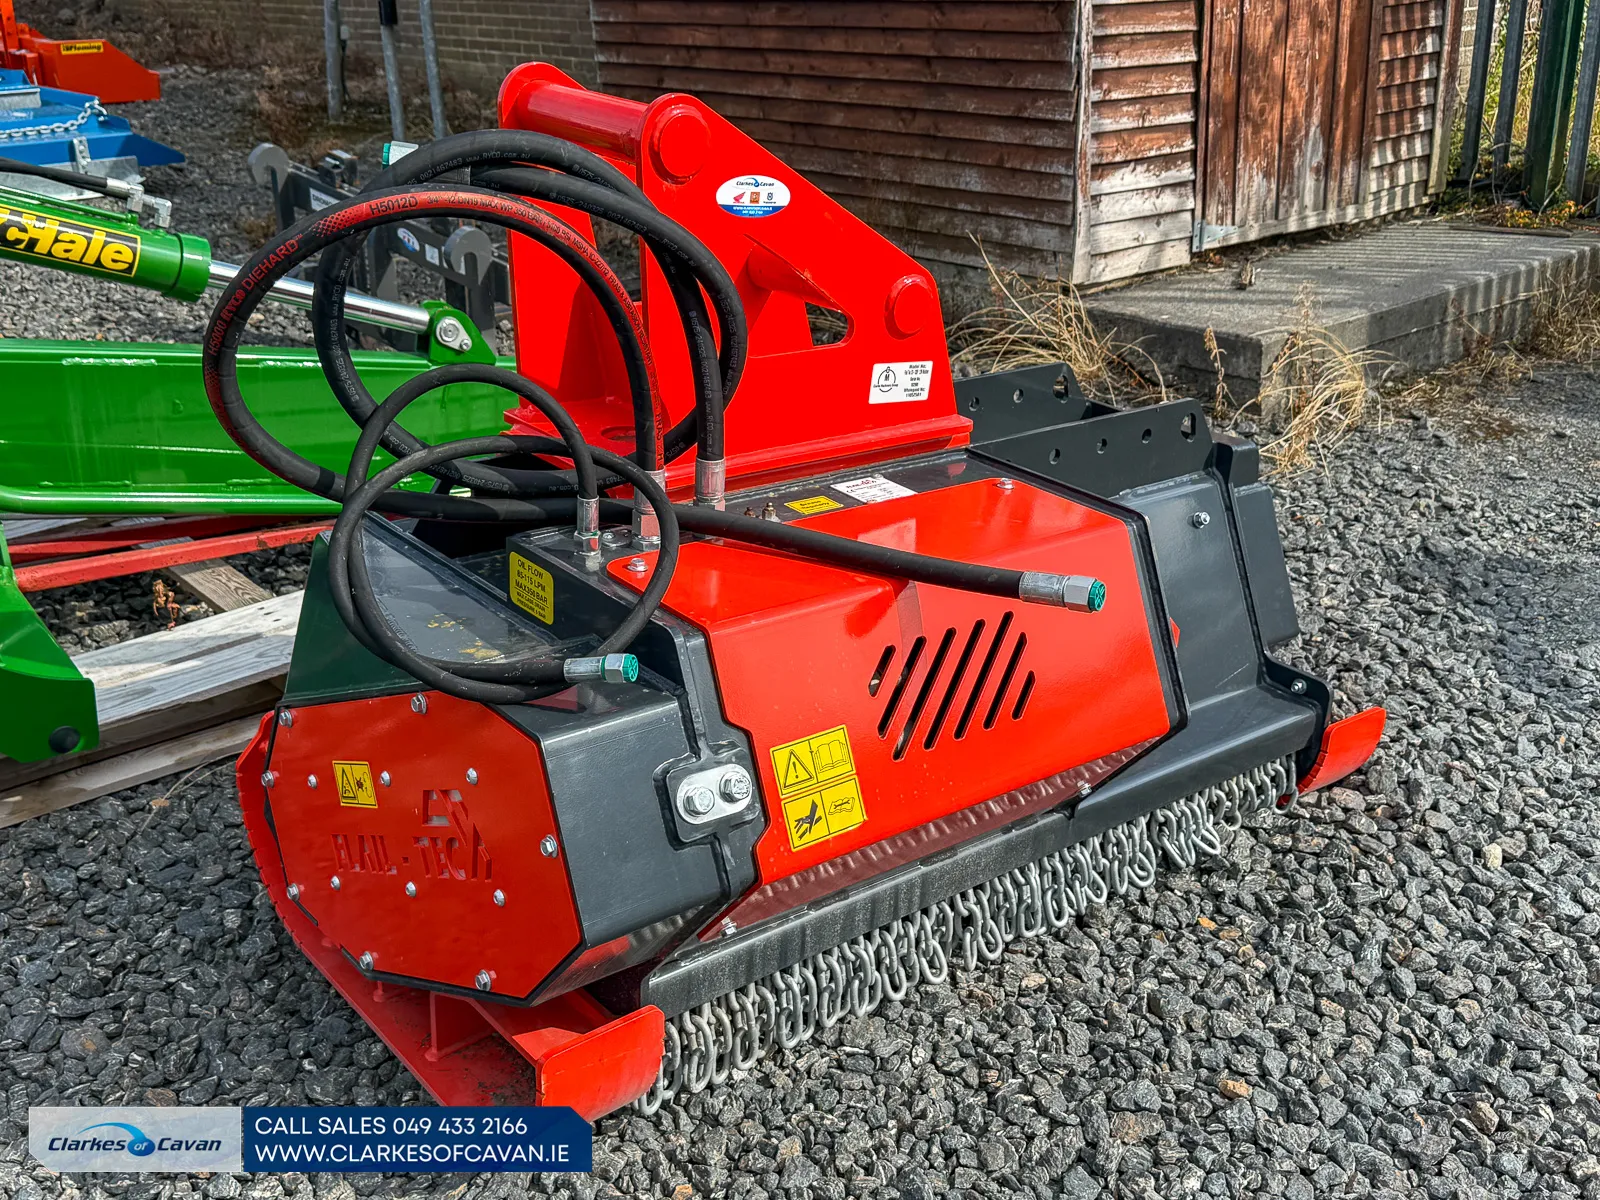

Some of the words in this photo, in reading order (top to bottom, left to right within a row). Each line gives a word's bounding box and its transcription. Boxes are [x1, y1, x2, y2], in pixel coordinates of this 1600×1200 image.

[369, 195, 419, 215] H5012D
[458, 196, 478, 206] DN19
[480, 198, 499, 209] MAX
[500, 202, 513, 212] WP
[514, 207, 527, 217] 350
[517, 558, 527, 570] OIL
[528, 565, 544, 580] FLOW
[534, 580, 546, 592] LPM
[331, 833, 397, 875] FLAIL
